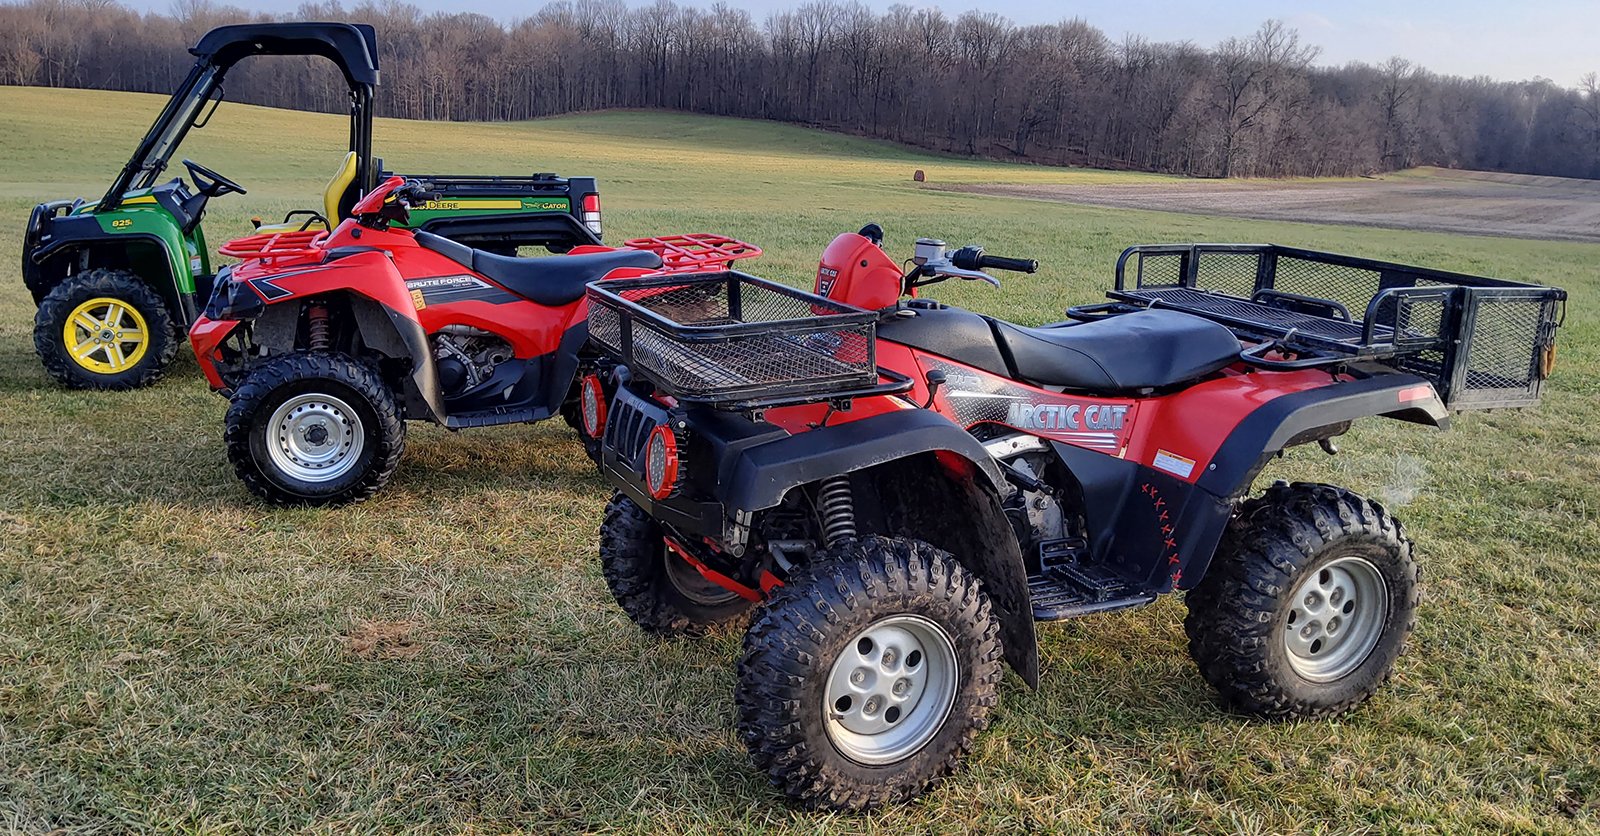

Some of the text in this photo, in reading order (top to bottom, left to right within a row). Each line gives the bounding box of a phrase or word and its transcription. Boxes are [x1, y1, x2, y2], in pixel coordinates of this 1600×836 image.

[430, 201, 459, 209] DEERE
[542, 202, 567, 210] GATOR
[406, 279, 440, 289] BRUTE
[440, 276, 472, 285] FORCE
[1006, 403, 1129, 430] ARCTIC CAT
